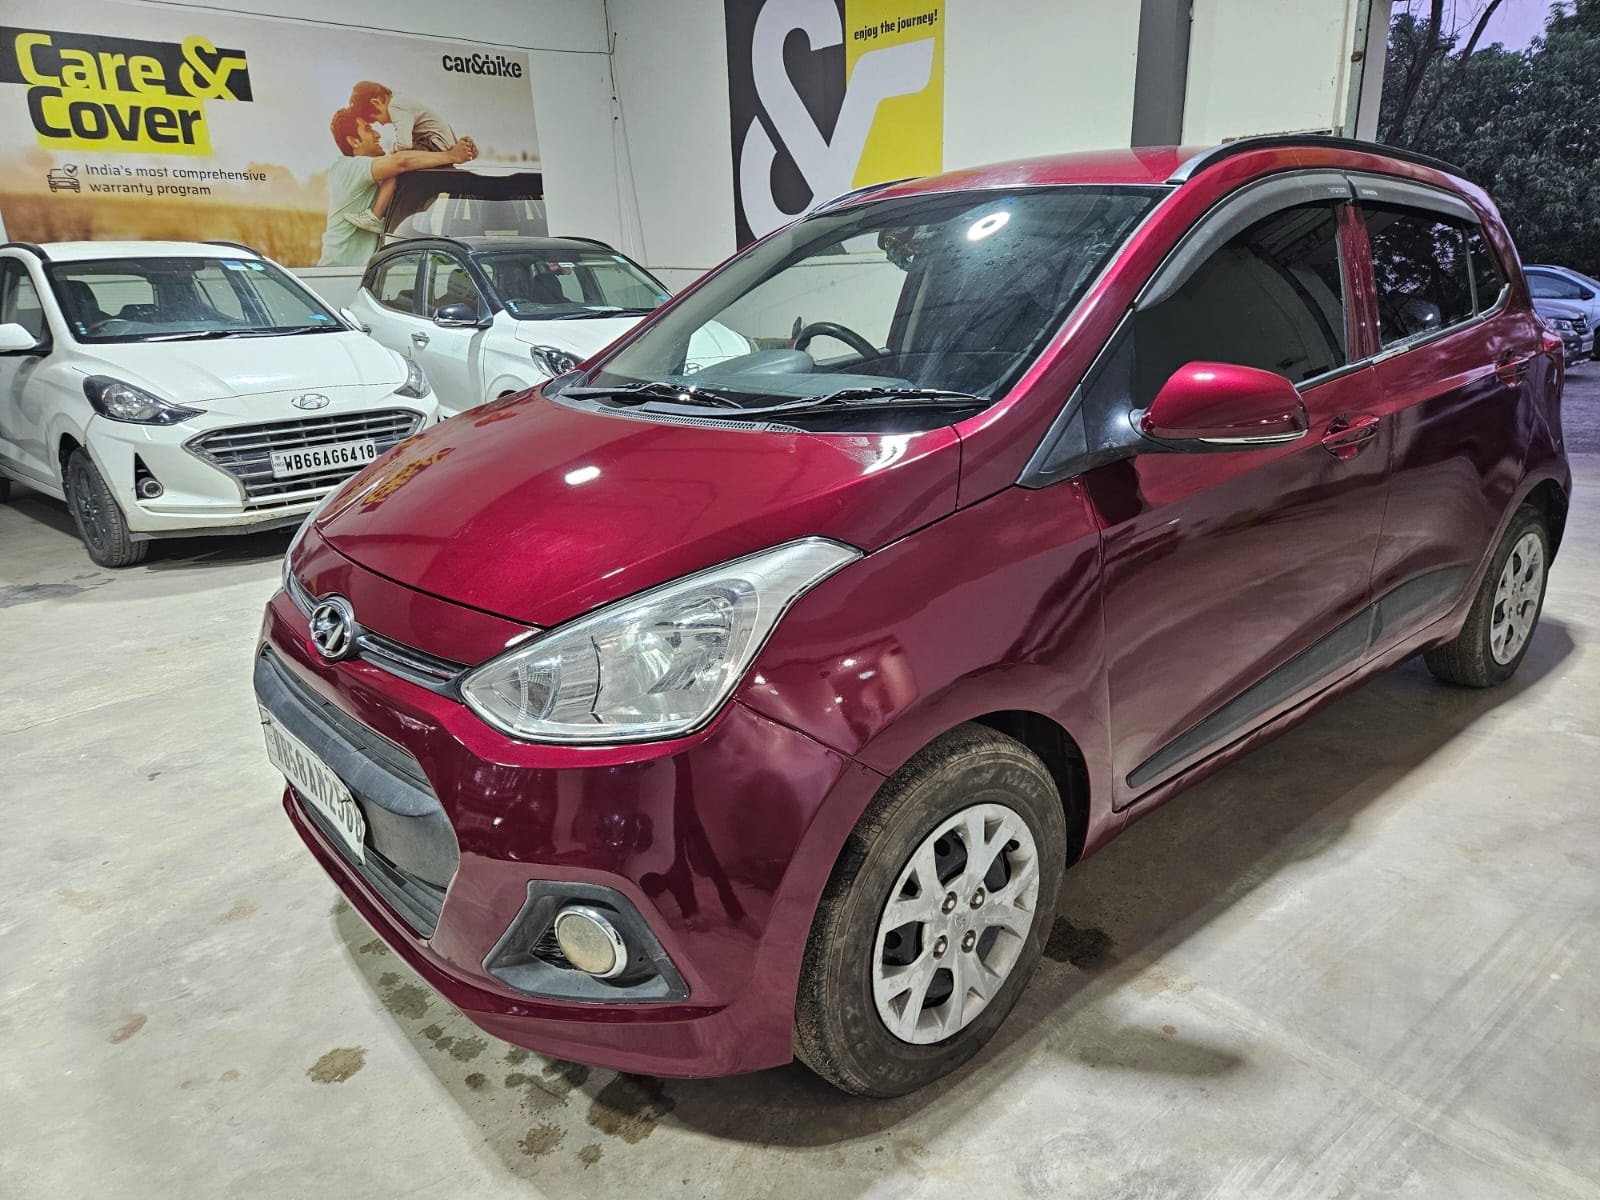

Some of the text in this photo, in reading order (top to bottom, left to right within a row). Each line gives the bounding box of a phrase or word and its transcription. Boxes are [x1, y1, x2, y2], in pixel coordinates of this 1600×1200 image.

[854, 8, 938, 41] enjoy the journey!
[15, 32, 247, 100] Care &
[442, 53, 522, 78] car&bike
[27, 86, 202, 145] Cover
[85, 163, 267, 182] India's most comprehensive
[89, 182, 211, 197] warranty program
[283, 444, 375, 471] WB66AG6418
